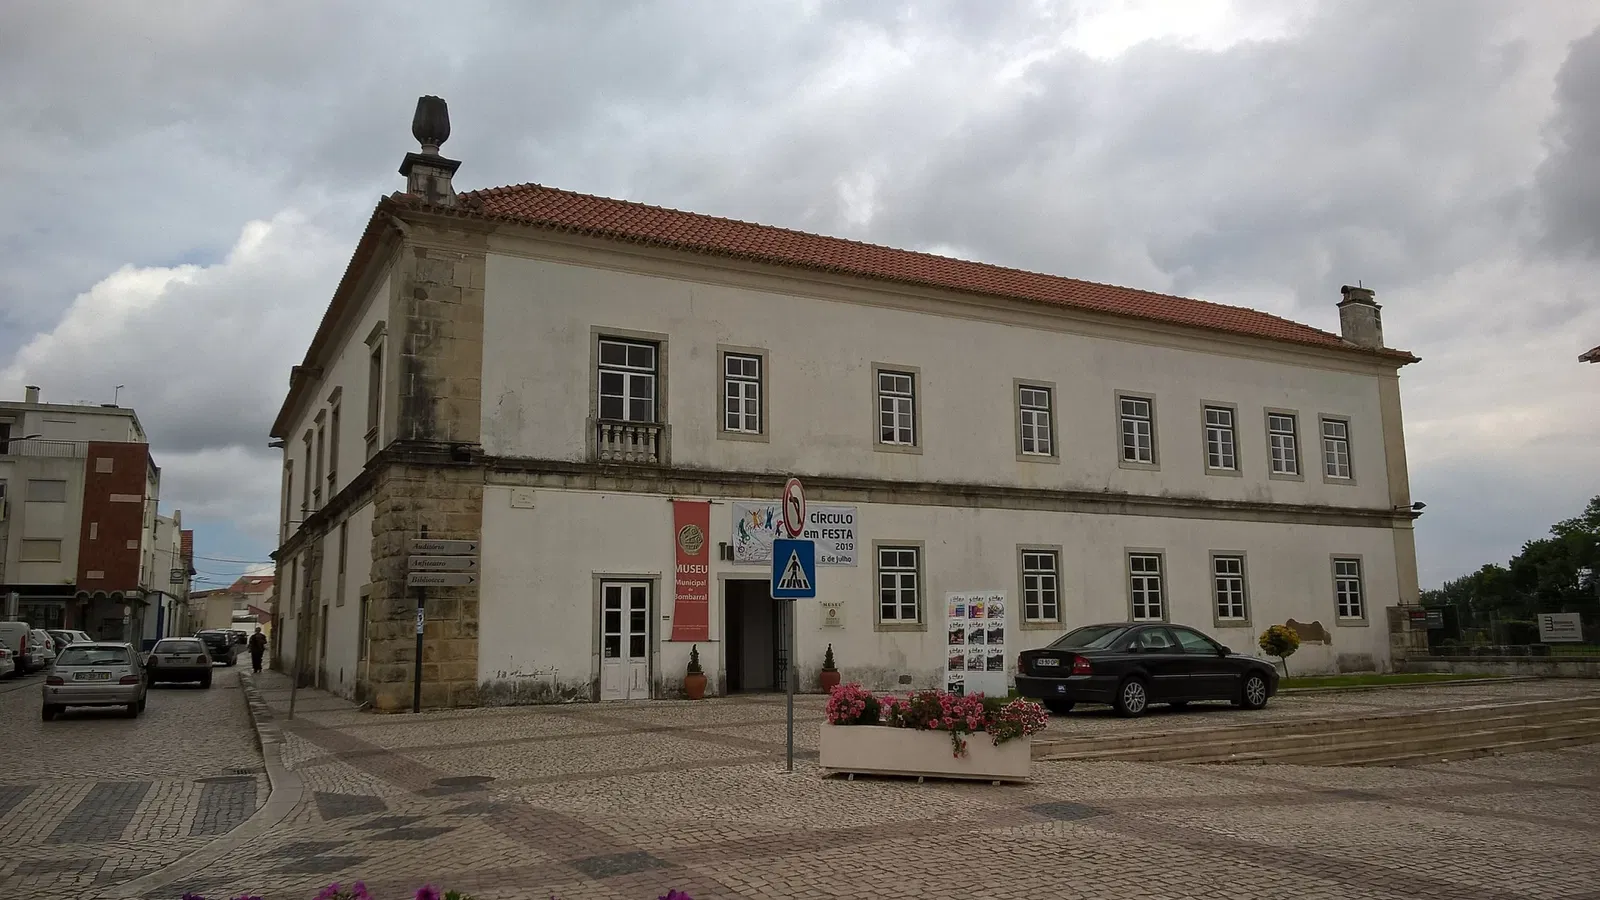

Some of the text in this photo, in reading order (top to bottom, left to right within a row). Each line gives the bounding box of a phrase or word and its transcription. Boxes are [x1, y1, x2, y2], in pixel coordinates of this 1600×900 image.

[811, 511, 853, 524] CÍRCULO
[804, 529, 853, 539] em FESTA
[835, 542, 854, 551] 2019
[676, 564, 708, 574] MUSEU
[411, 575, 445, 583] Biblioteca
[675, 579, 707, 587] Municipal
